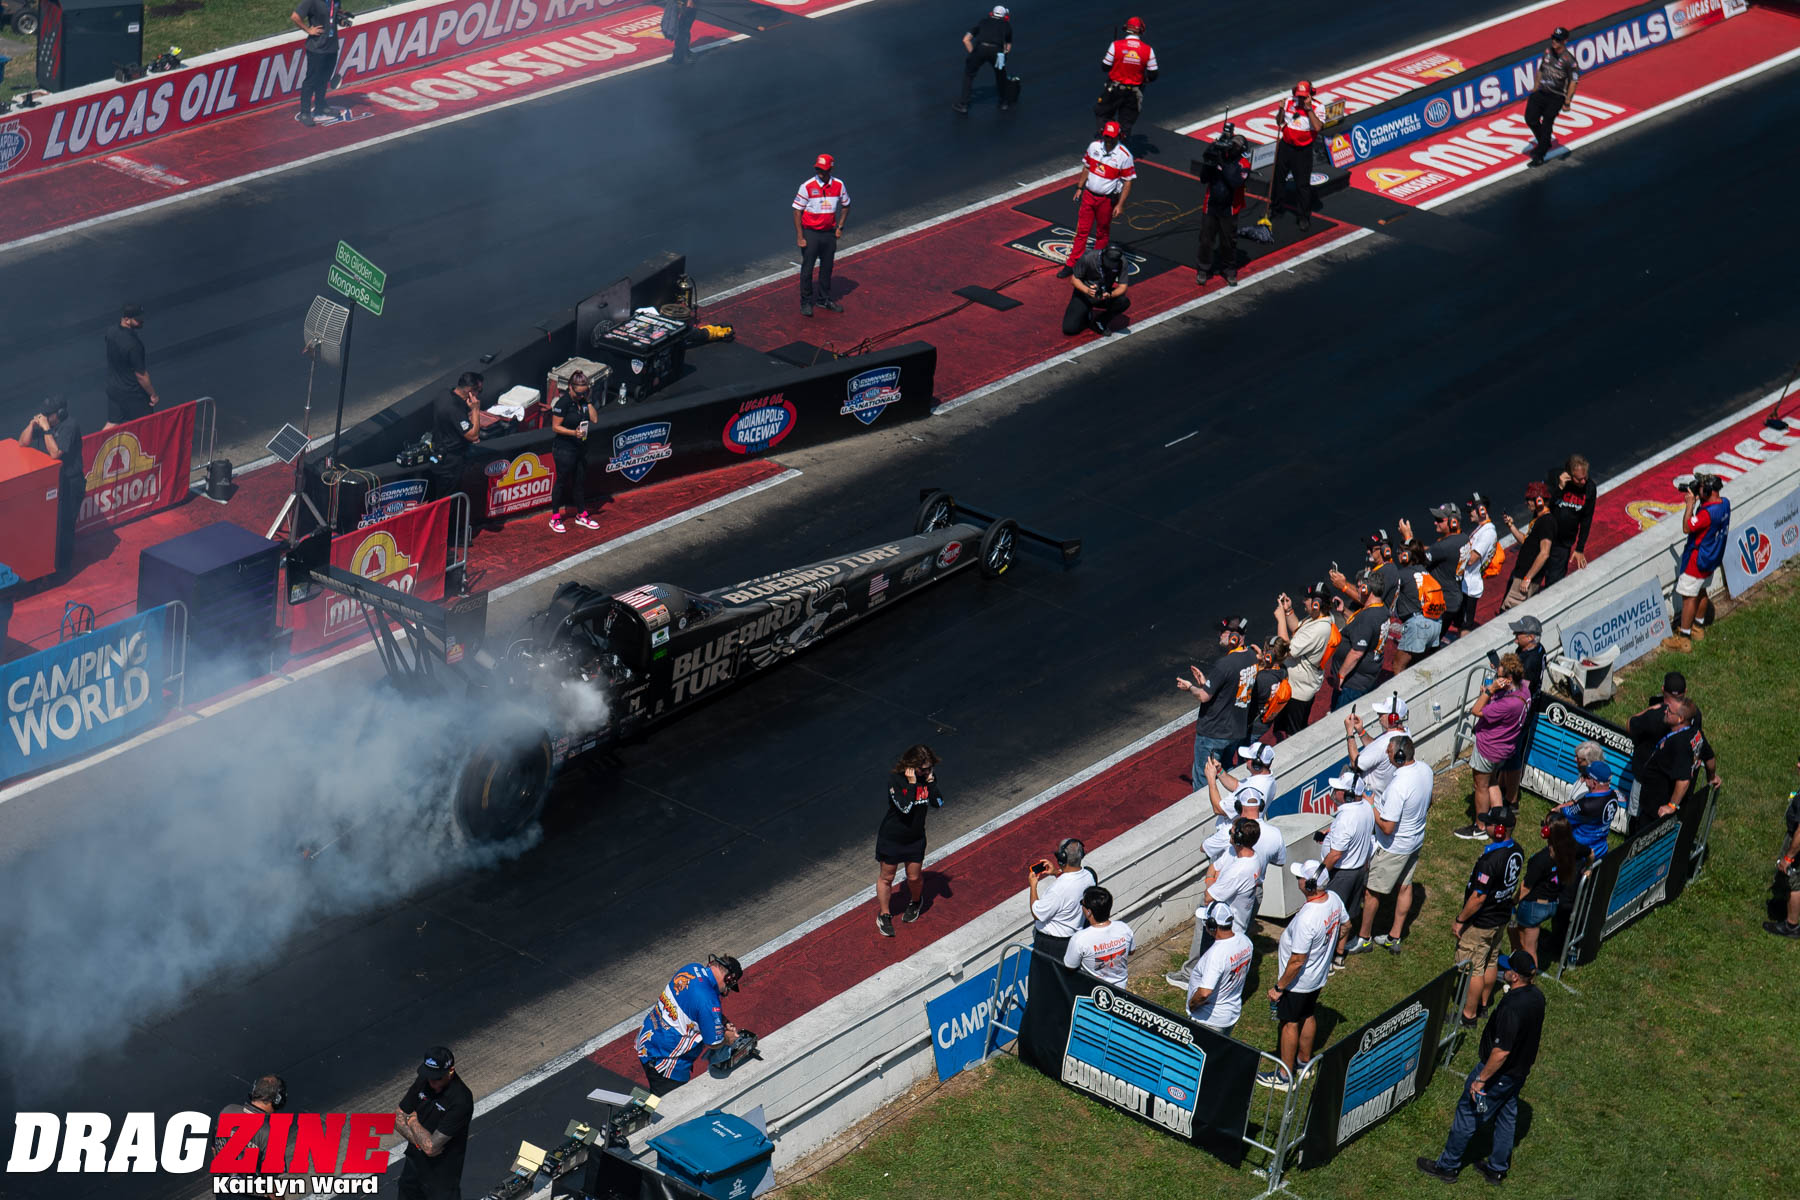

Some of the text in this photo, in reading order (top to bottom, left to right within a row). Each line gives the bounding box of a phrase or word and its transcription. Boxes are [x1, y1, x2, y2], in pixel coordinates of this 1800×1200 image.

[42, 0, 538, 160] LUCAS OIL INIANAPOLIS
[366, 30, 637, 112] MISSION
[1453, 14, 1667, 119] U.S. NONALS
[1370, 112, 1421, 138] CORNWELL
[1427, 104, 1449, 122] NHRA
[1371, 122, 1422, 148] QUALITY TOOLS
[1389, 173, 1446, 199] MISSION
[338, 246, 350, 264] Bob
[351, 256, 373, 281] Glidden
[860, 371, 897, 385] CORNWELL
[739, 393, 784, 413] LUCAS OIL
[841, 393, 901, 414] U.S. NATIONALS
[736, 408, 785, 431] INDIANAPOLIS
[737, 421, 782, 443] RACEWAY
[626, 427, 667, 440] CORNWELL
[607, 449, 671, 471] U.S. NATIONALS
[632, 445, 650, 456] NHRA
[380, 483, 423, 498] CORNWELL
[493, 478, 551, 505] MISSION
[386, 502, 404, 514] NHRA
[1738, 525, 1760, 575] VP
[721, 564, 842, 605] BLUEBIRD
[836, 544, 902, 569] TURF
[1593, 595, 1658, 640] CORNWELL
[1594, 624, 1631, 653] QUALITY
[1634, 607, 1661, 629] TOOLS
[671, 599, 802, 682] BLUEBIRD
[8, 631, 148, 713] CAMPING
[9, 666, 150, 756] WORLD
[1565, 720, 1602, 740] QUALITY
[1566, 712, 1635, 749] CORNWELL
[1093, 937, 1126, 953] Mitutoyo
[1112, 1006, 1190, 1045] QUALITY TOOLS
[1114, 997, 1191, 1038] CORNWELL
[1374, 1001, 1423, 1035] CORNWELL
[1063, 1054, 1192, 1135] BURNOUT BOX
